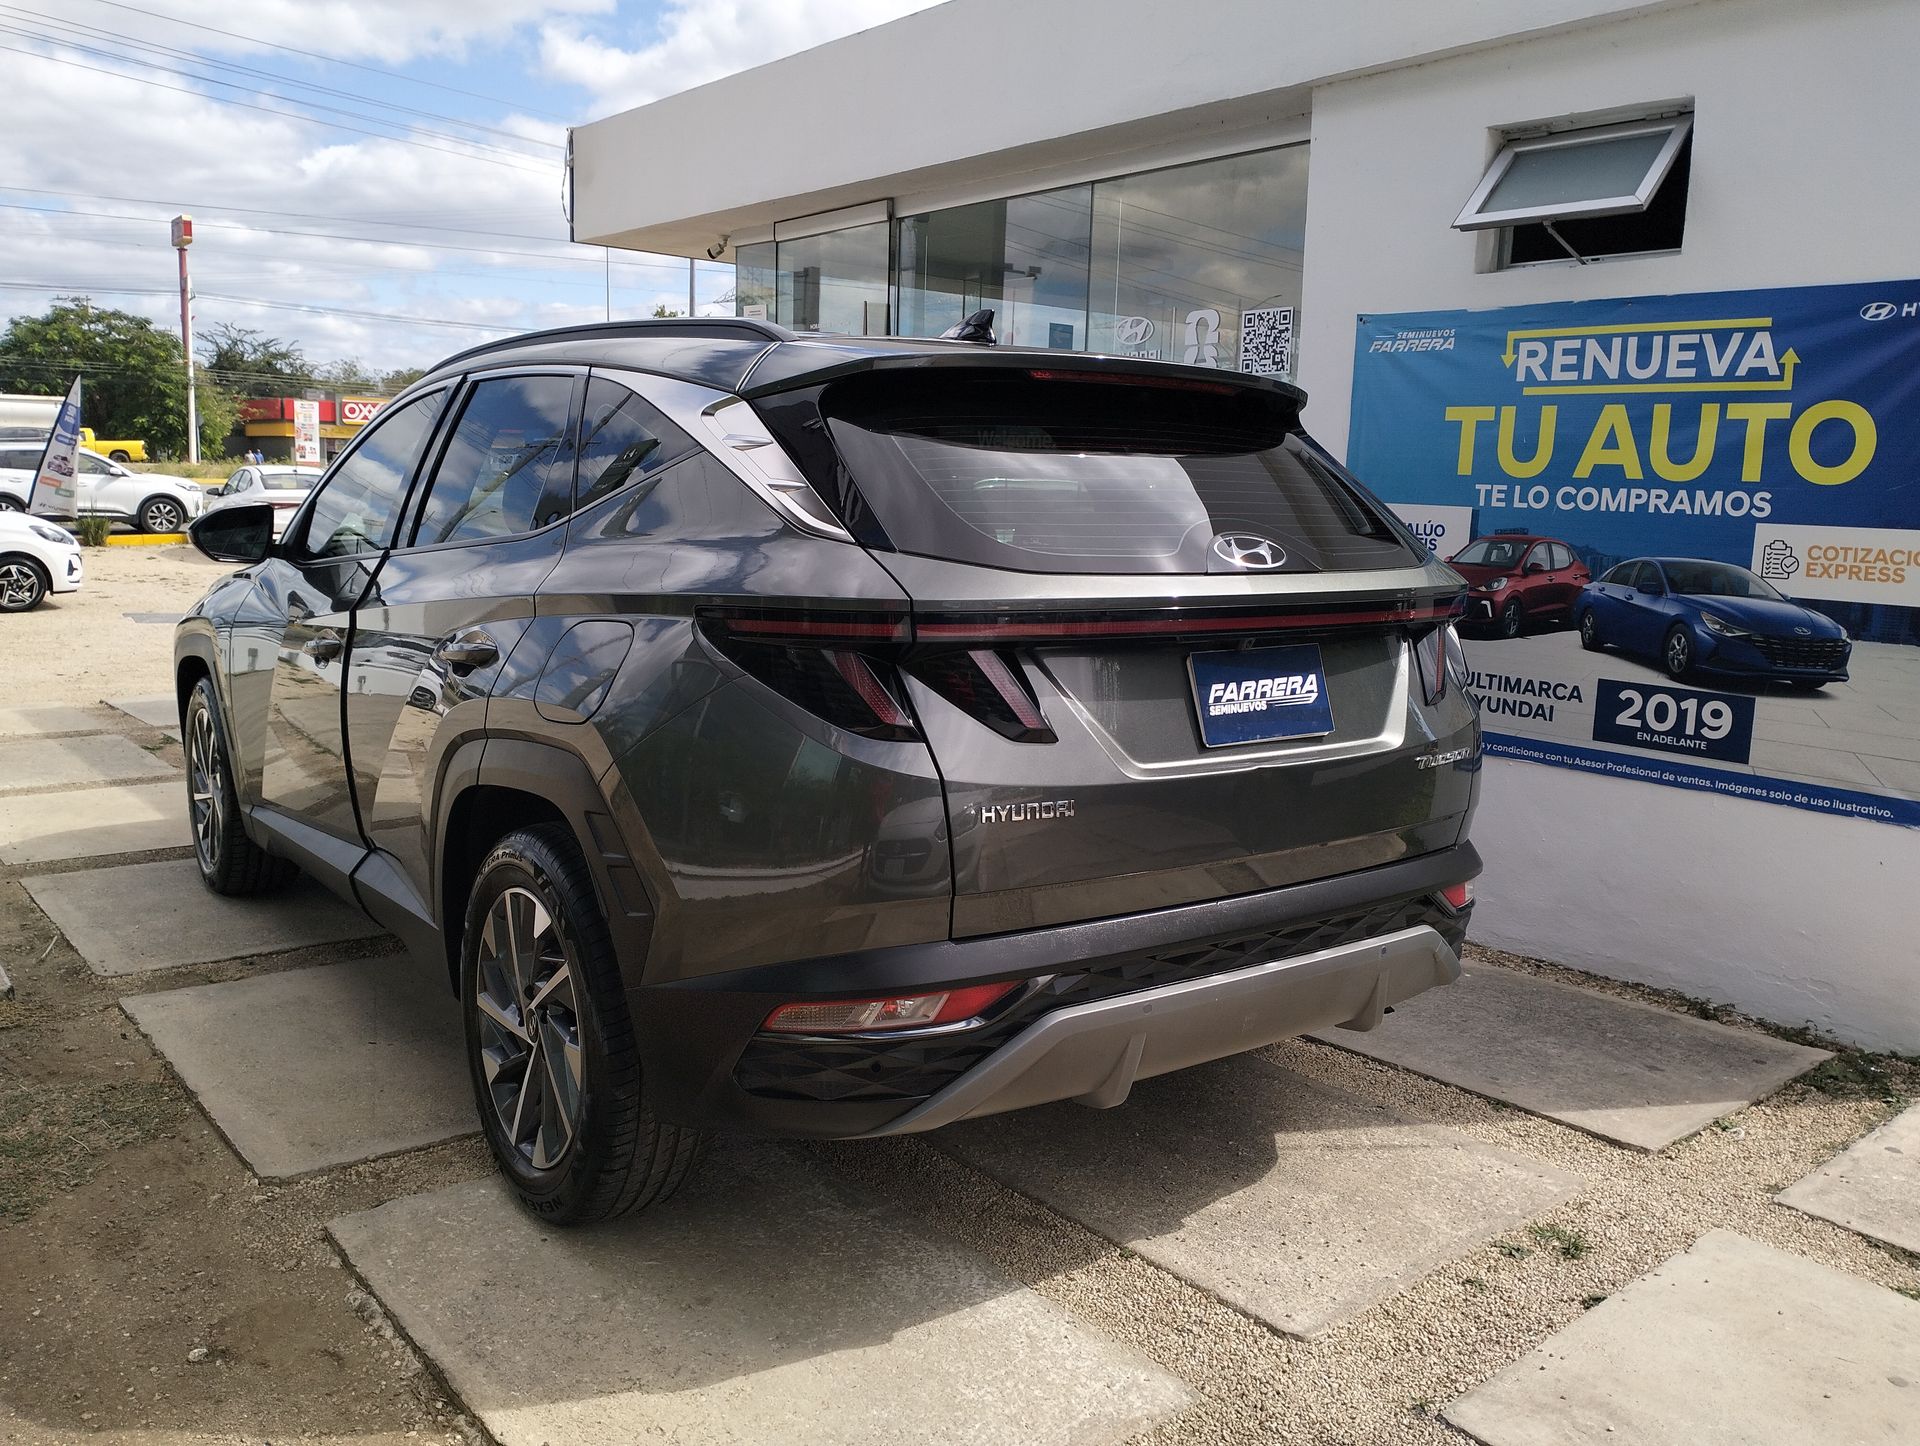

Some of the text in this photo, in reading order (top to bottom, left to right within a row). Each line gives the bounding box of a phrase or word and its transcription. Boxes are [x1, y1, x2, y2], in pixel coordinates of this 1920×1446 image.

[1368, 337, 1455, 353] FARRERA
[1397, 329, 1455, 339] SEMINUEVOS
[1516, 331, 1780, 382] RENUEVA
[344, 402, 384, 420] OXX
[1445, 400, 1877, 486] TU AUTO
[1475, 484, 1772, 518] TE LO COMPRAMOS
[1406, 520, 1446, 537] ALÚO
[1805, 562, 1906, 584] EXPRESS
[1208, 673, 1318, 704] FARRERA
[1467, 672, 1583, 703] ULTIMARCA
[1209, 701, 1268, 717] SEMINUEVOS
[1474, 694, 1554, 722] YUNDAI
[1615, 689, 1733, 740] 2019
[1636, 731, 1708, 750] EN ADELANTE
[1493, 744, 1544, 759] condiciones
[1545, 753, 1562, 762] con
[1563, 755, 1573, 764] tu
[1574, 757, 1605, 770] Asesor
[1606, 762, 1661, 779] Profesional
[1662, 771, 1675, 781] de
[1677, 775, 1714, 788] ventas.
[1715, 780, 1768, 797] Imágenes
[1769, 789, 1792, 801] solo
[1794, 793, 1808, 804] de
[1810, 797, 1830, 808] uso
[1832, 799, 1894, 819] ilustrativo.
[981, 800, 1075, 824] HYUNDAI
